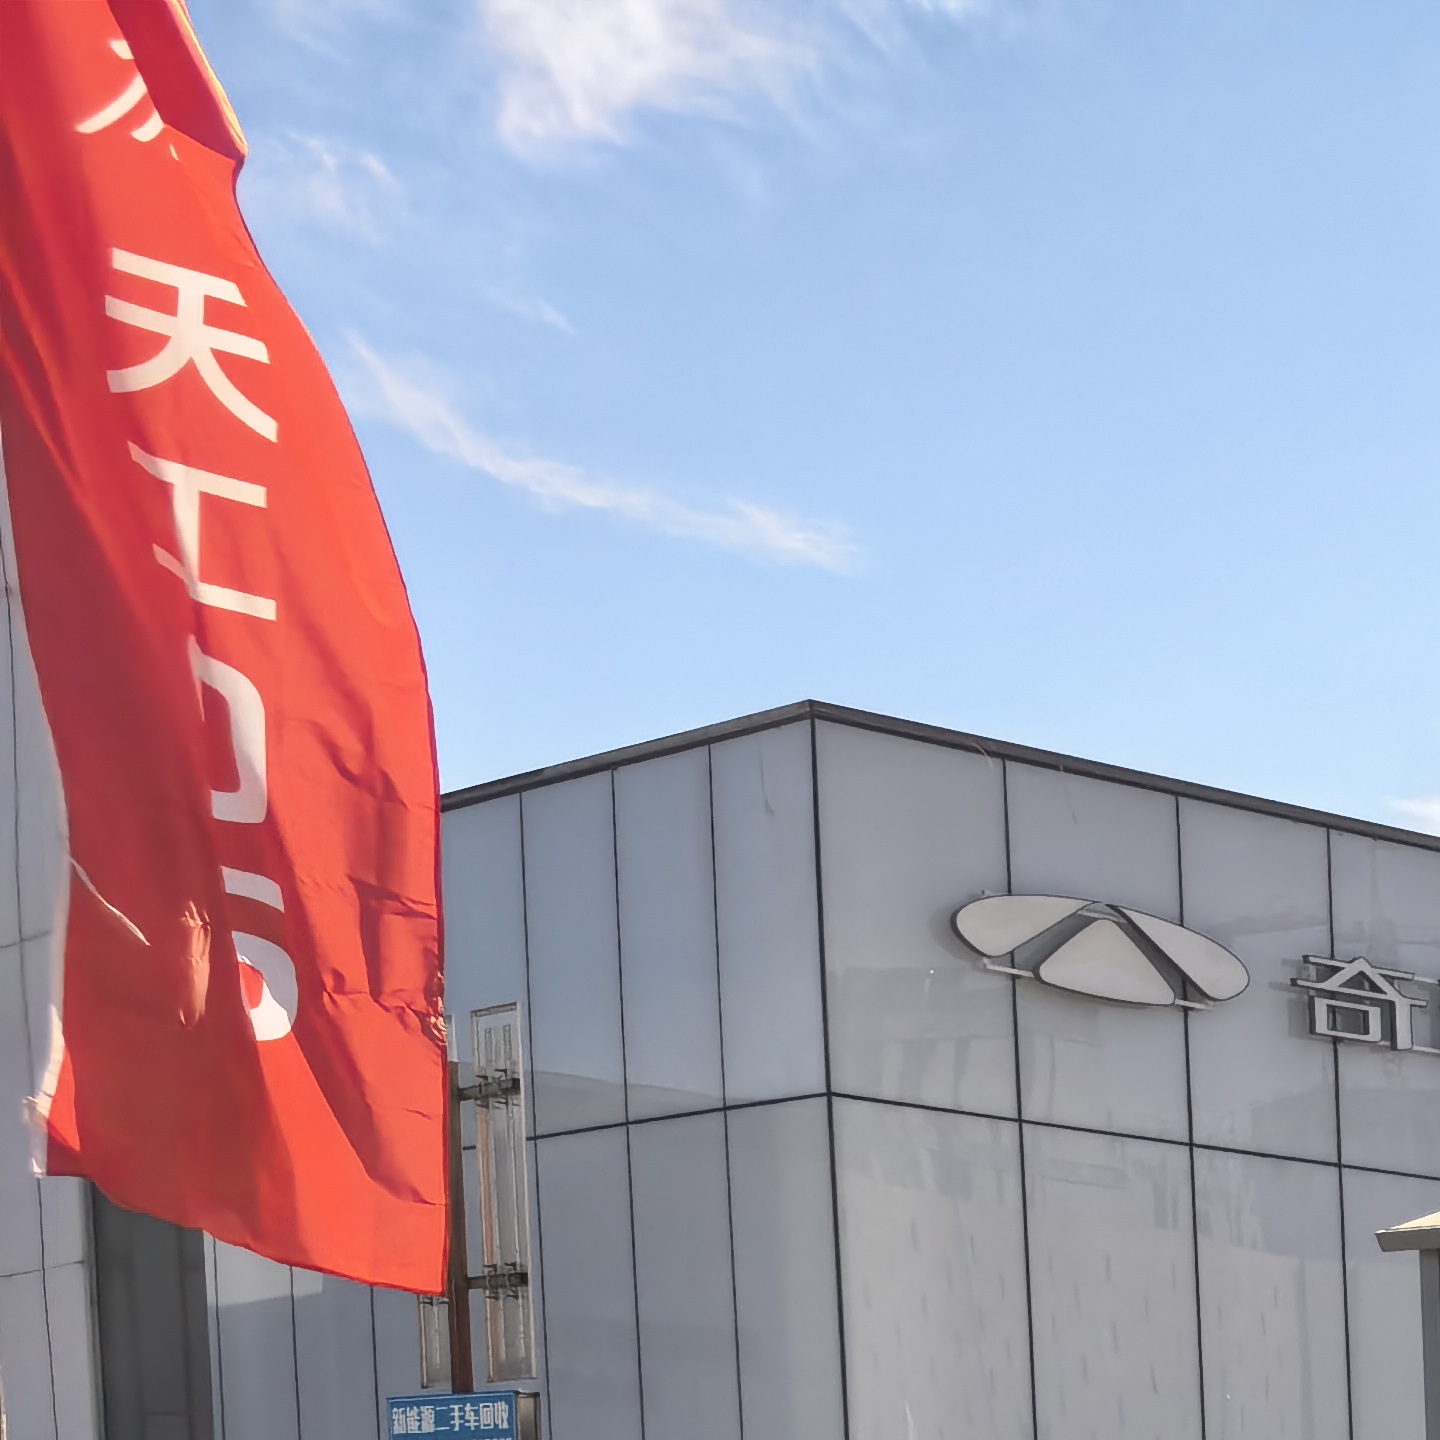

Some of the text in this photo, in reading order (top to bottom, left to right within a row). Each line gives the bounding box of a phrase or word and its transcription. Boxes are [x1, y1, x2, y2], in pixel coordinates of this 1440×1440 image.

[392, 1401, 510, 1435] 新能源二手车回收
